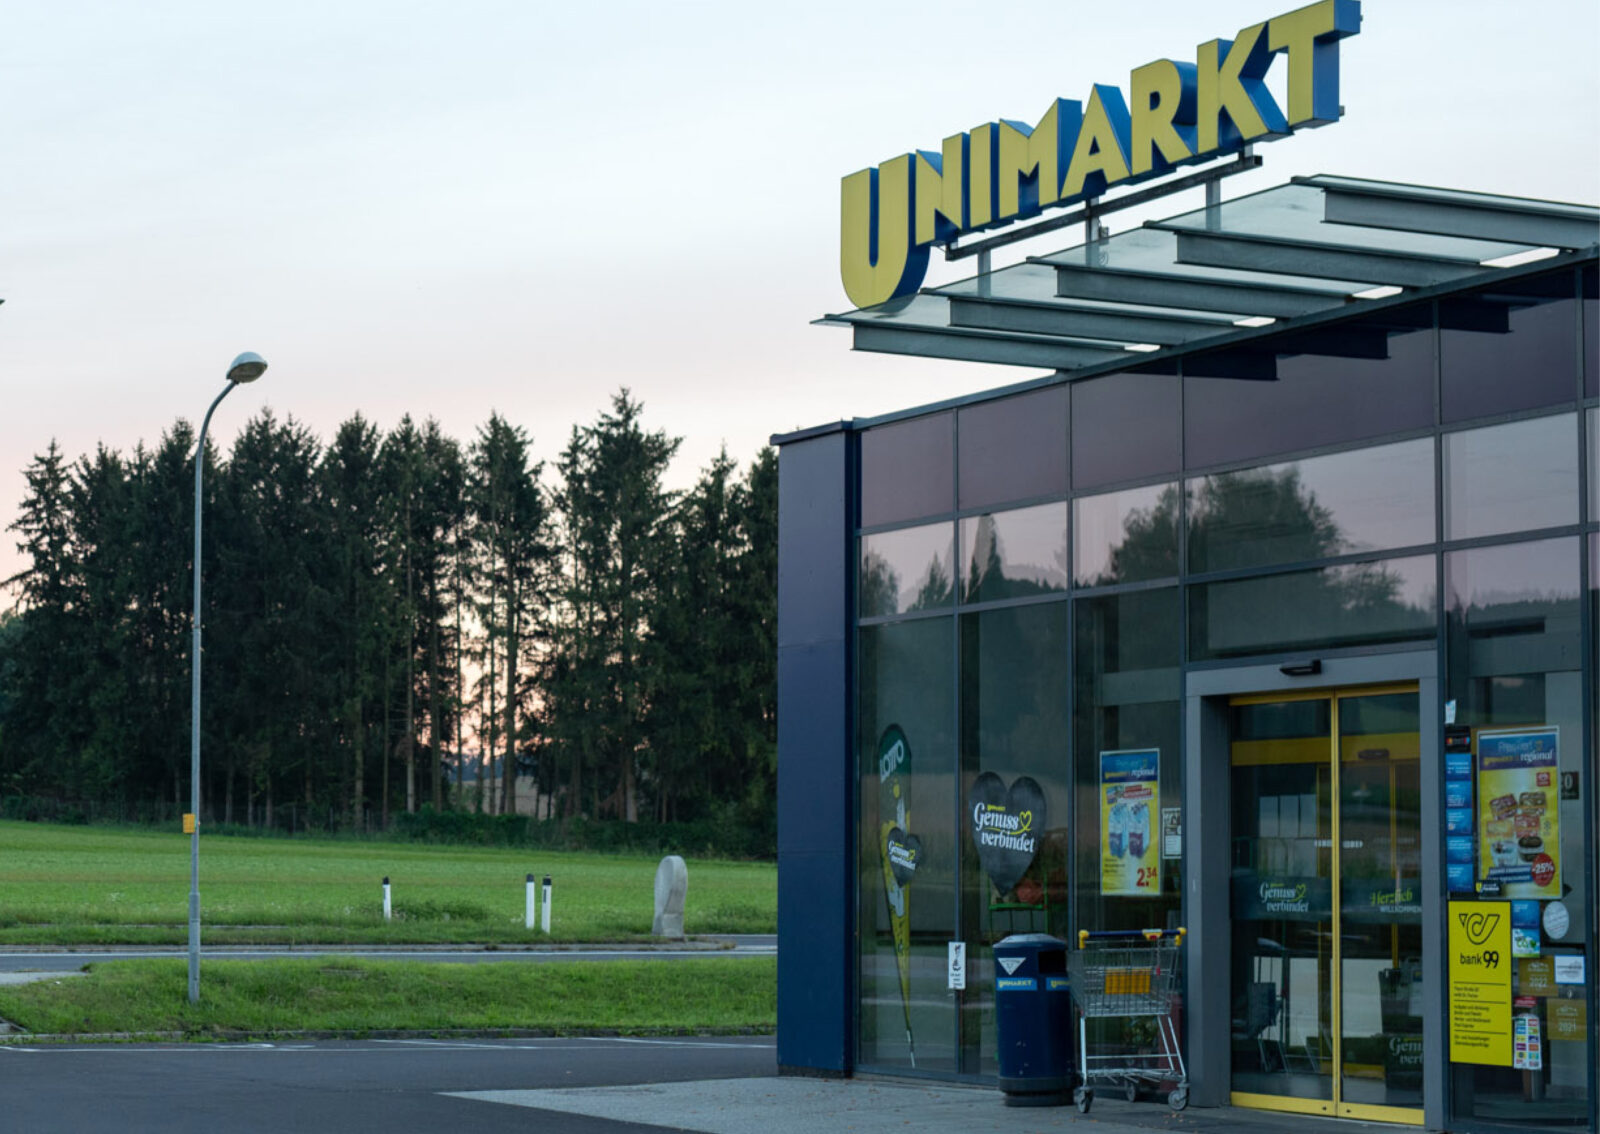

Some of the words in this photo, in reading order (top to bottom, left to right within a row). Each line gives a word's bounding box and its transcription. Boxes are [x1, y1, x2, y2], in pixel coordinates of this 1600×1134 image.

[841, 0, 1361, 312] UNIMARKT
[879, 739, 904, 783] LOTTO
[1520, 749, 1553, 764] regional
[1130, 766, 1155, 779] regional
[974, 802, 1020, 831] Genuss
[981, 830, 1035, 853] verbindet
[1260, 881, 1296, 902] Genuss
[1266, 899, 1309, 913] verbindet
[1460, 952, 1482, 966] bank
[1483, 950, 1499, 968] 99
